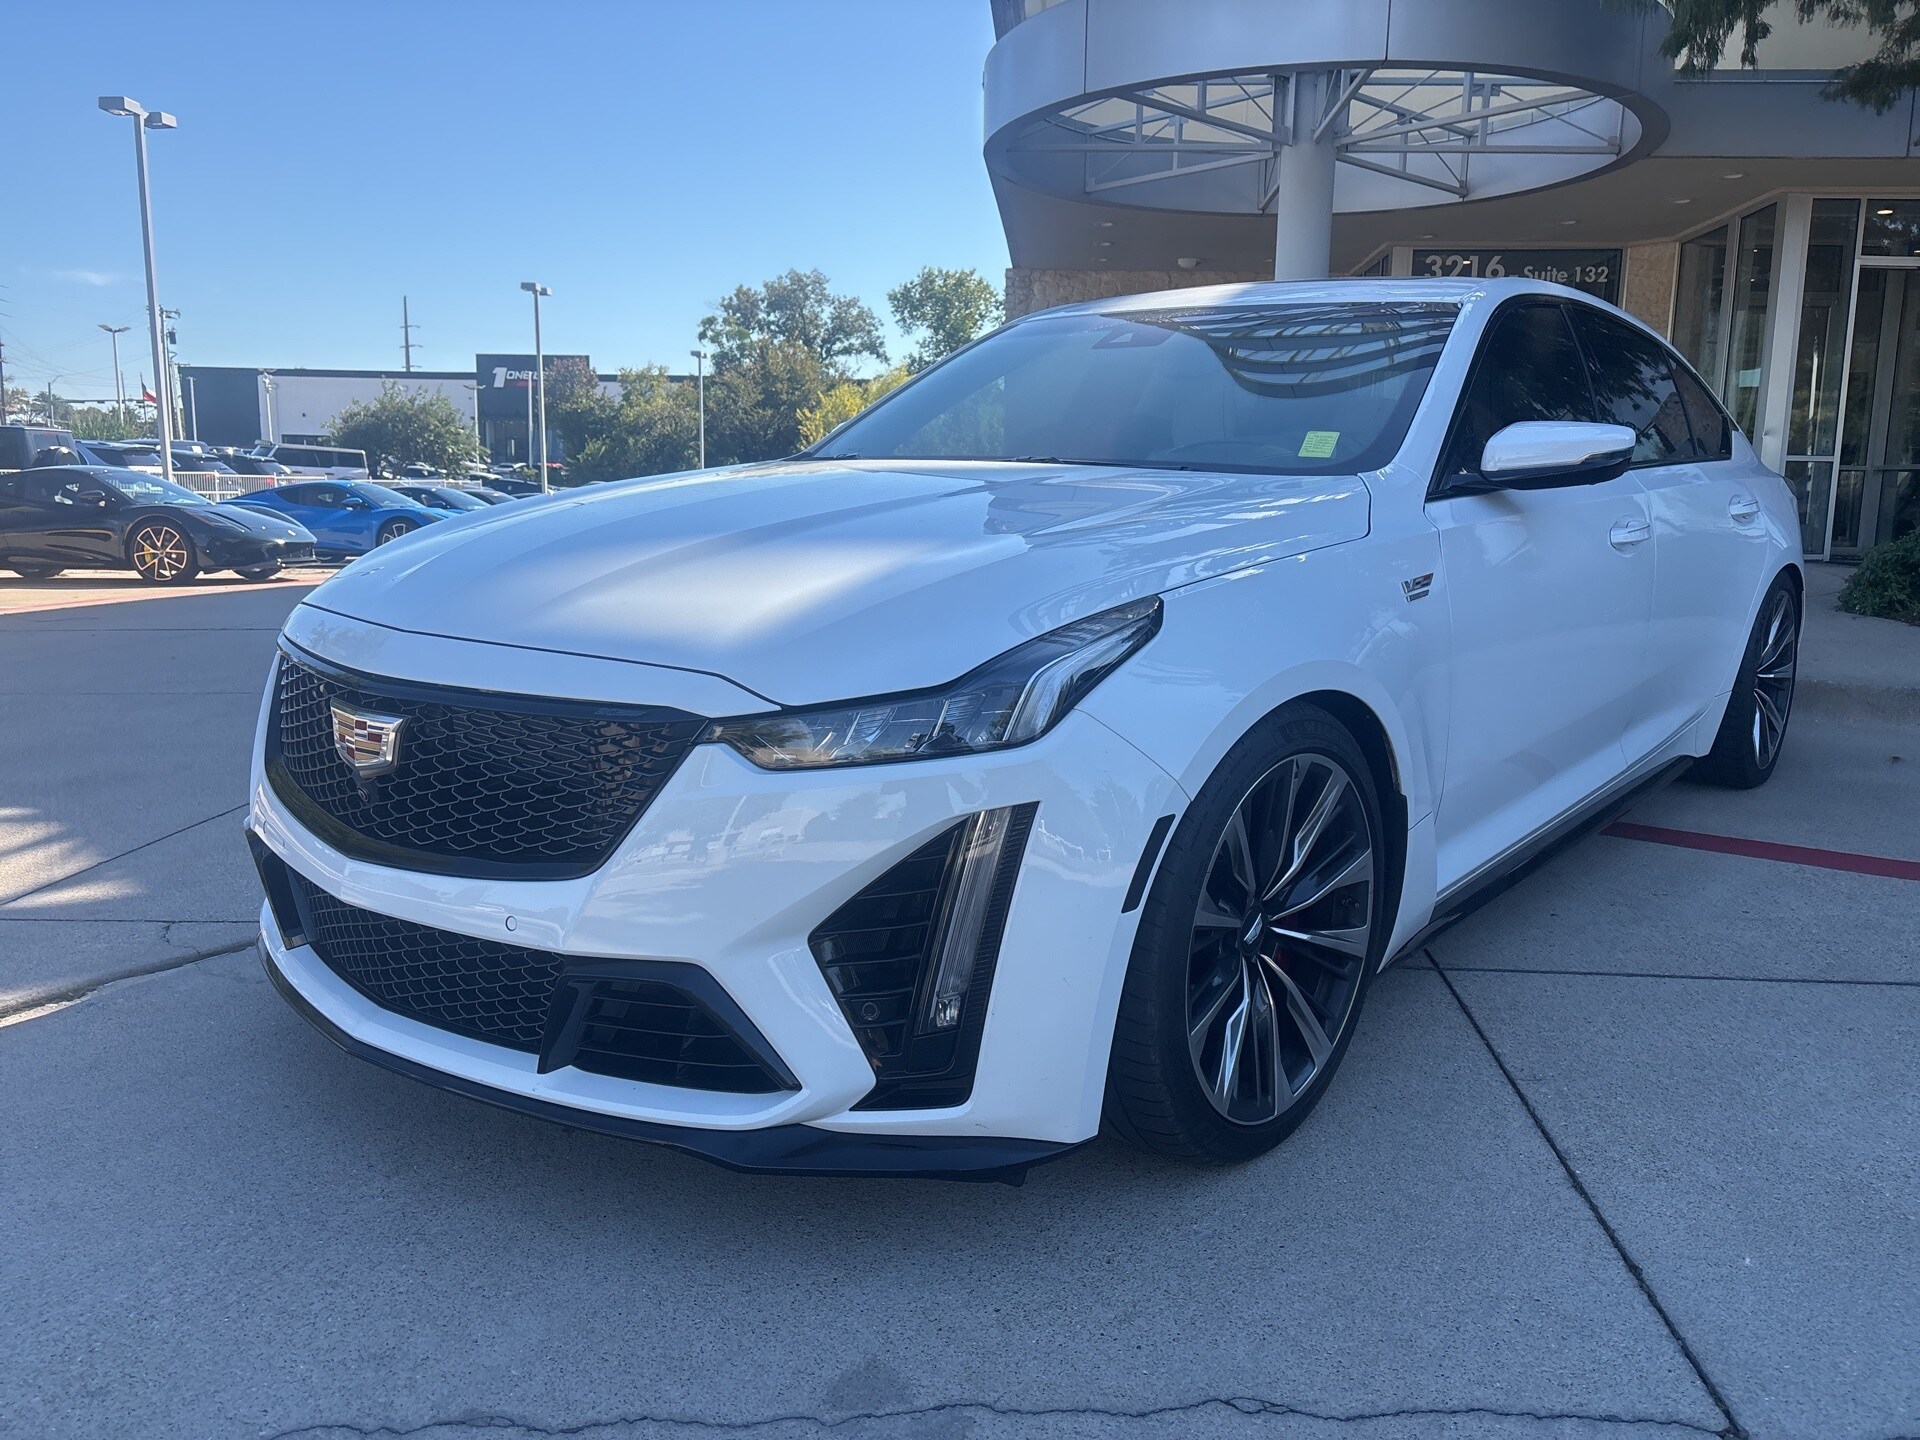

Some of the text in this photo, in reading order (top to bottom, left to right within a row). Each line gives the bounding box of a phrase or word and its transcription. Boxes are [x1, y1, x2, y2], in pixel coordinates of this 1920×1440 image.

[1424, 254, 1609, 283] 3216 Suite 132
